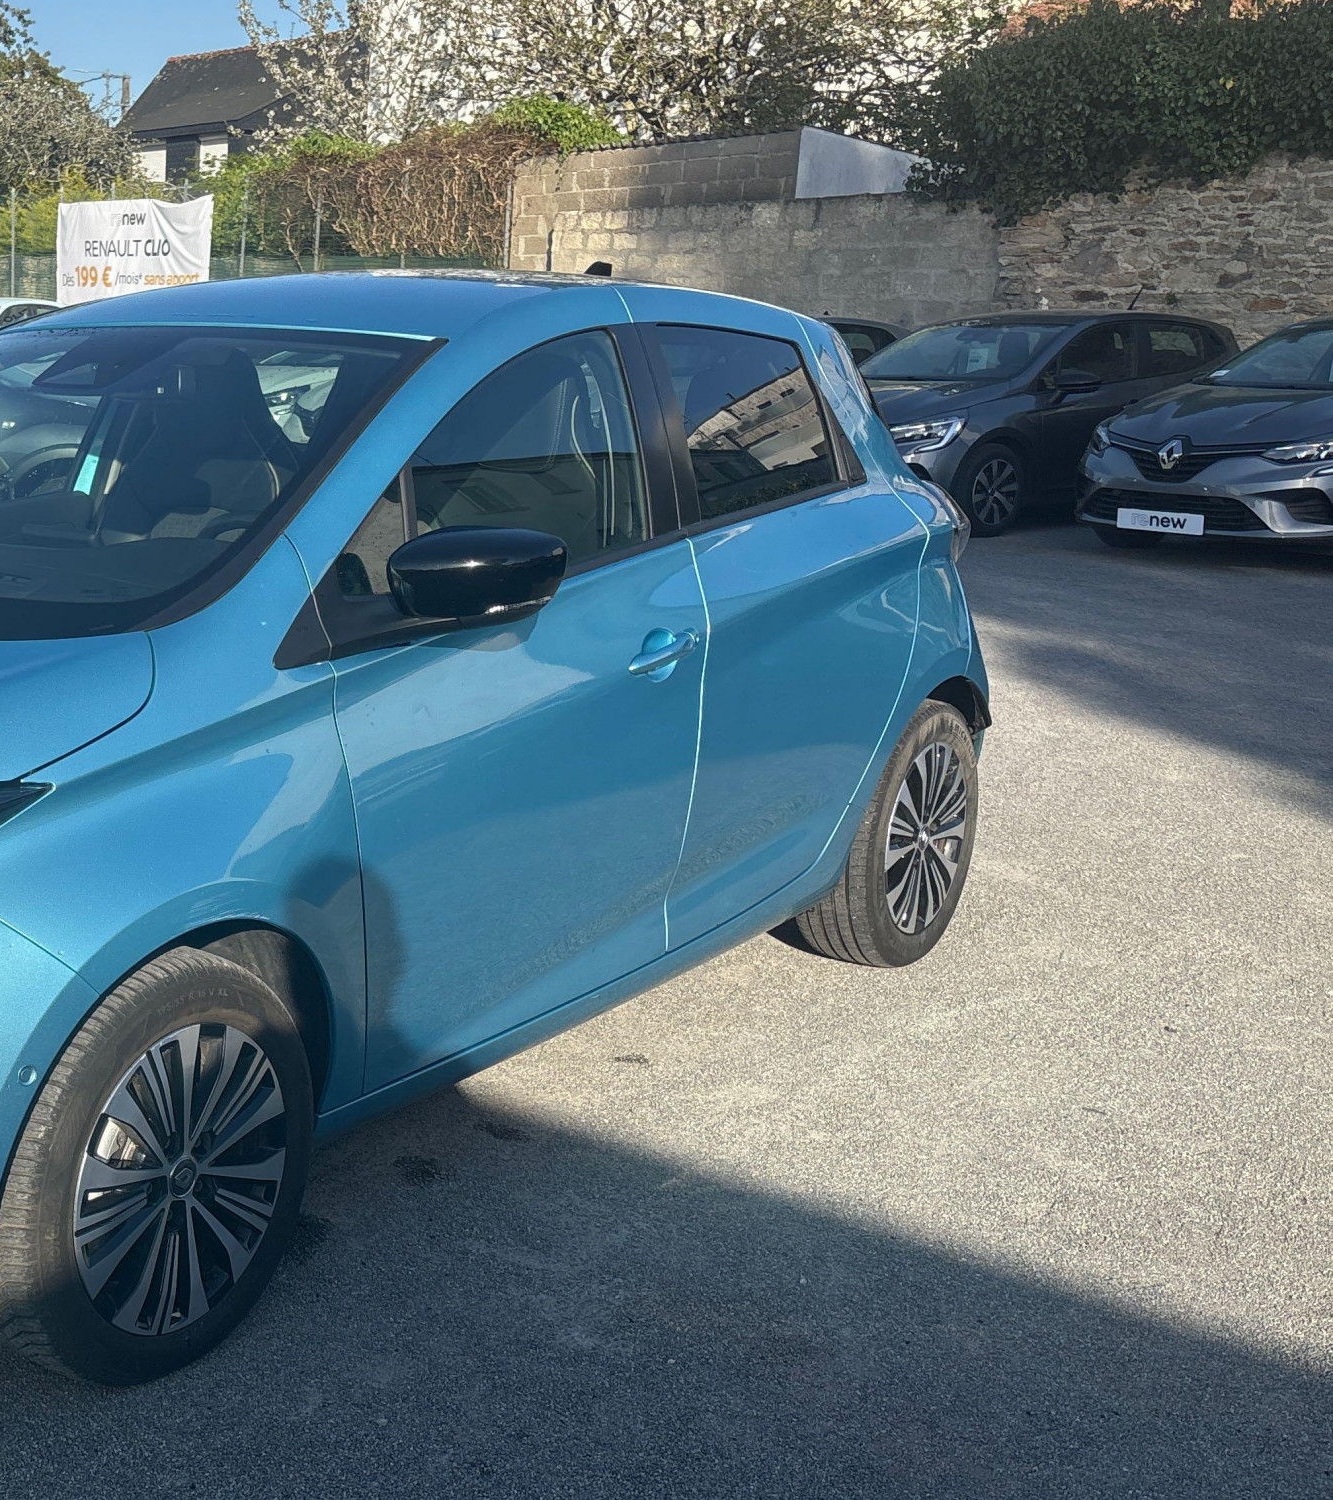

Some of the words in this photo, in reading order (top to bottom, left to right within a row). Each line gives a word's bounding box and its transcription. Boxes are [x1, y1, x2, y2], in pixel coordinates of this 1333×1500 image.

[84, 239, 142, 258] RENAULT
[144, 239, 171, 257] CLIO
[62, 273, 75, 287] Dès
[75, 265, 98, 288] 199
[102, 265, 112, 288] €
[143, 274, 165, 286] sans
[1130, 512, 1188, 530] renew
